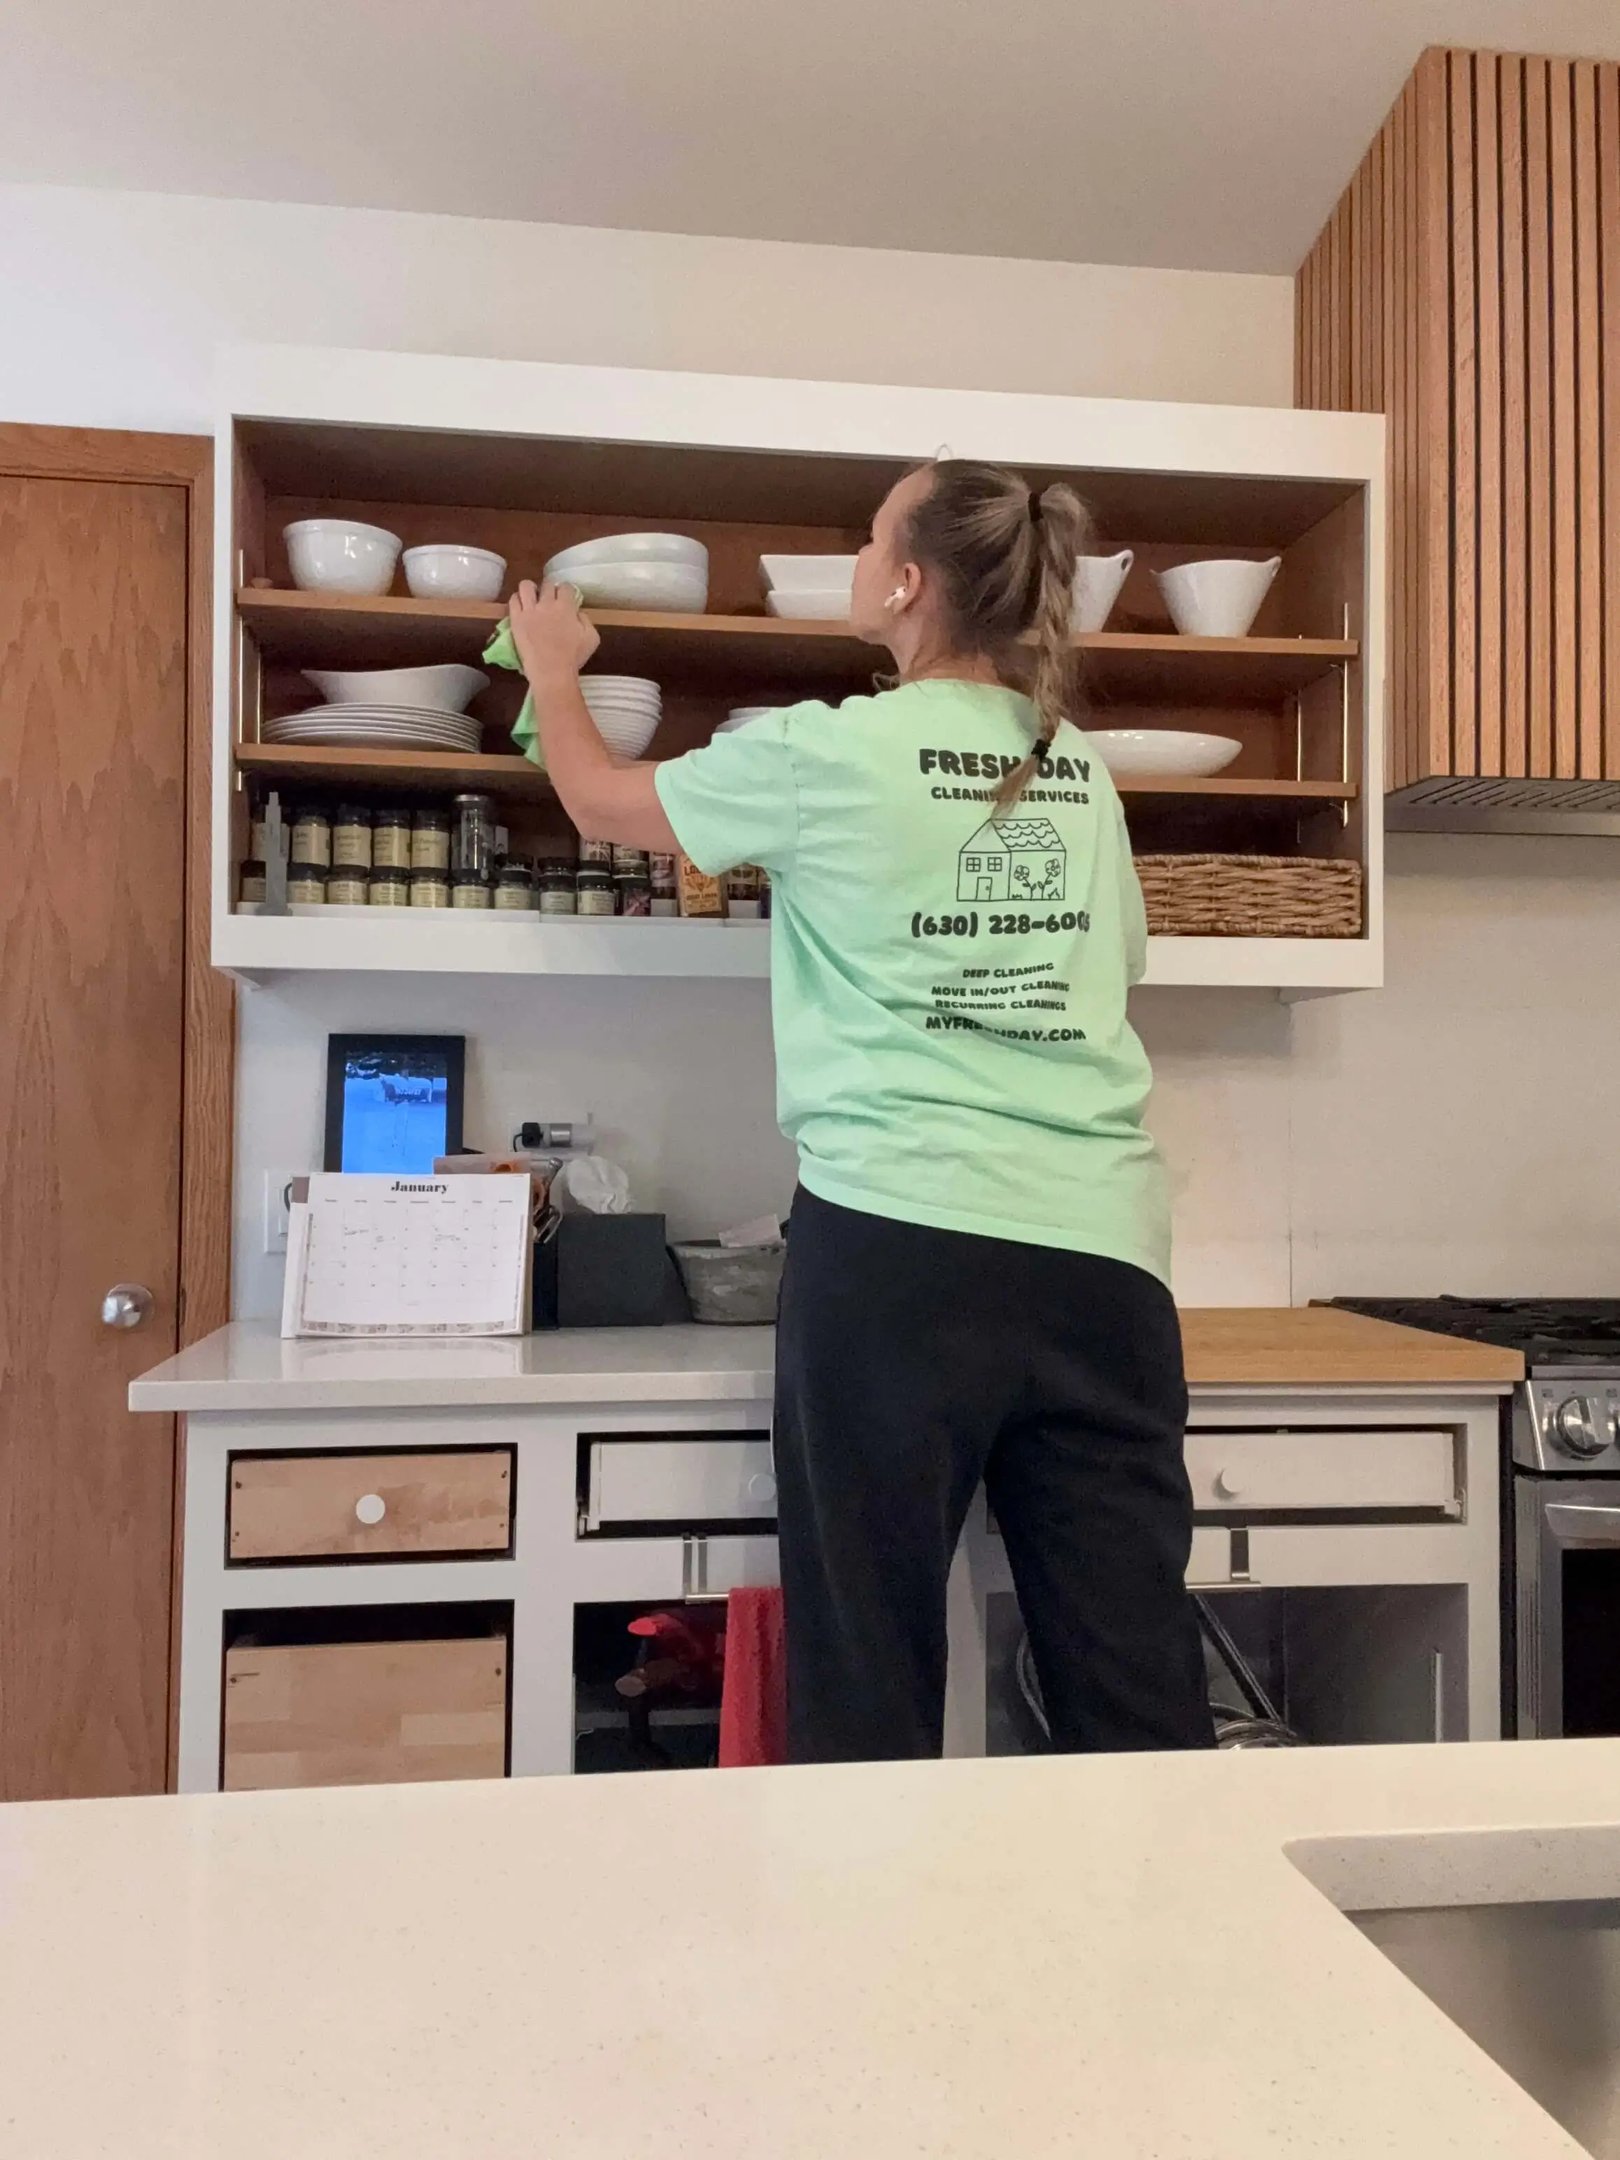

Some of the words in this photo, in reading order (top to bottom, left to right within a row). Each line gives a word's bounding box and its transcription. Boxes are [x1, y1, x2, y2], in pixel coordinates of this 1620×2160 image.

[1037, 756, 1090, 783] DAY
[1020, 790, 1090, 805] SERVICES
[911, 911, 978, 938] (630)
[963, 968, 990, 979] DEEP
[994, 962, 1054, 978] CLEANING
[931, 986, 966, 997] MOVE
[970, 985, 1017, 997] IN/OUT
[1021, 980, 1070, 993] CLEANING
[935, 999, 1006, 1011] RECURRING
[1011, 999, 1066, 1011] CLEANINGS
[926, 1016, 1086, 1041] MYFREHDAY.COM
[390, 1181, 449, 1195] January
